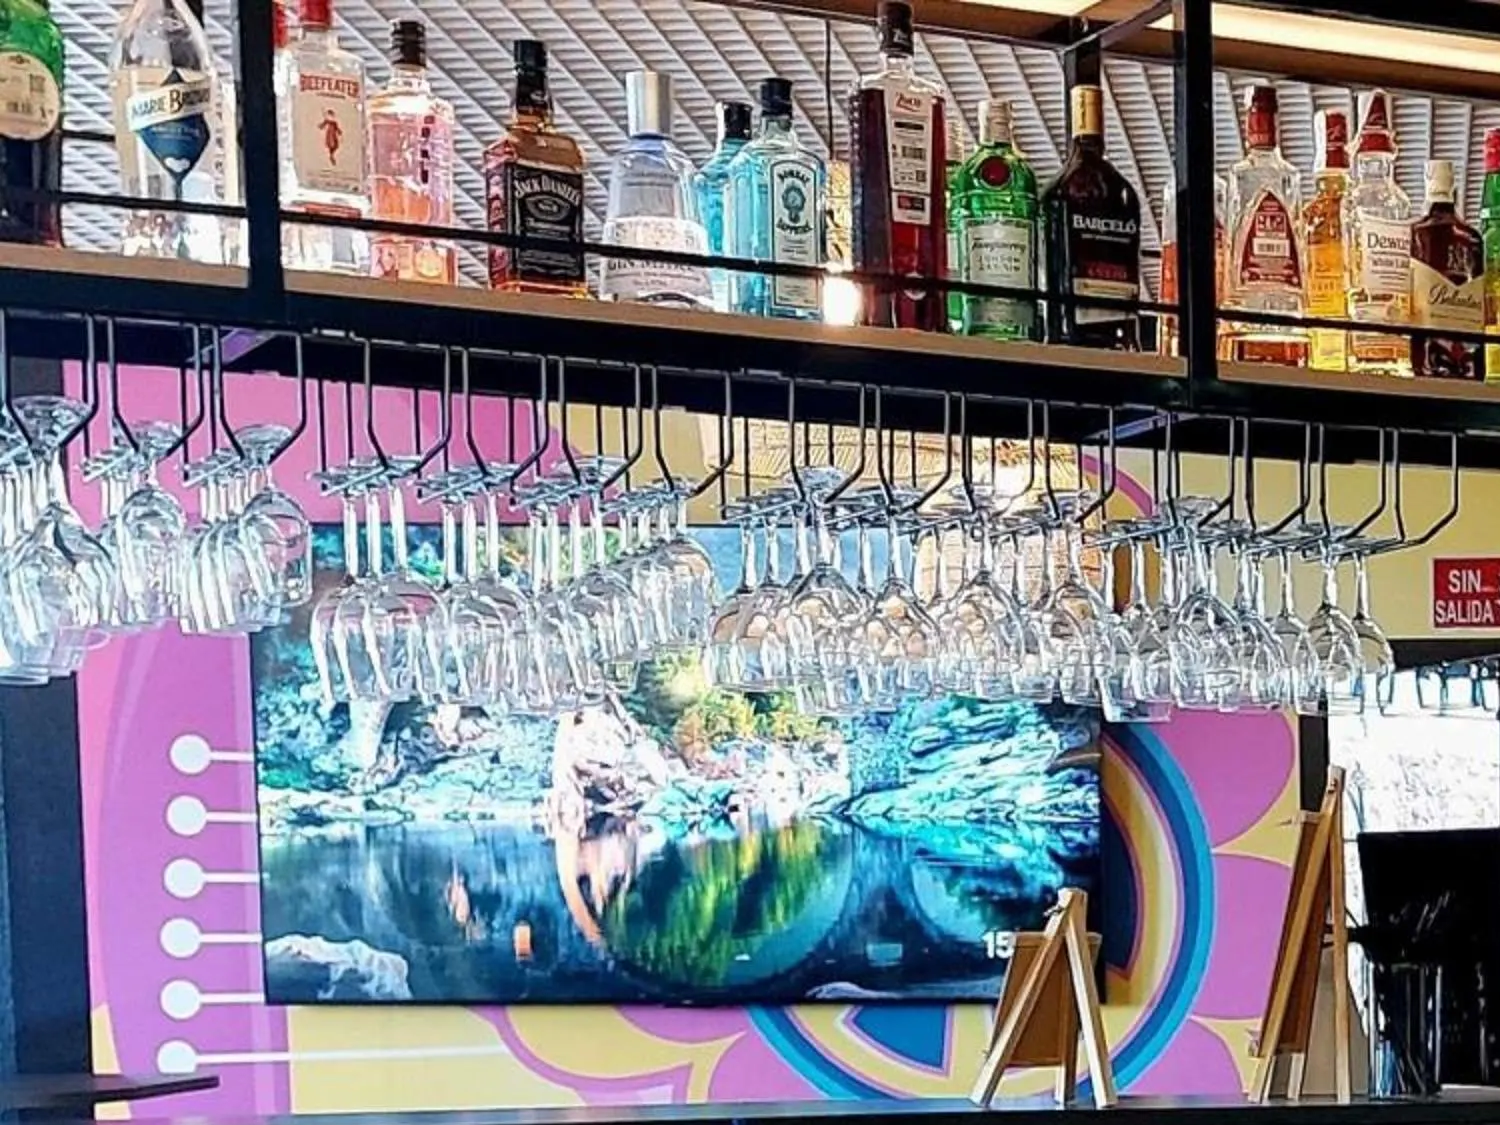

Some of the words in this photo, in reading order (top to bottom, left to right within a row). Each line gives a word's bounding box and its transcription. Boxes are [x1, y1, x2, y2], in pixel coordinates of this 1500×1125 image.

[1072, 214, 1137, 234] BARCELÓ
[1447, 568, 1482, 594] SIN
[1435, 599, 1495, 624] SALIDA
